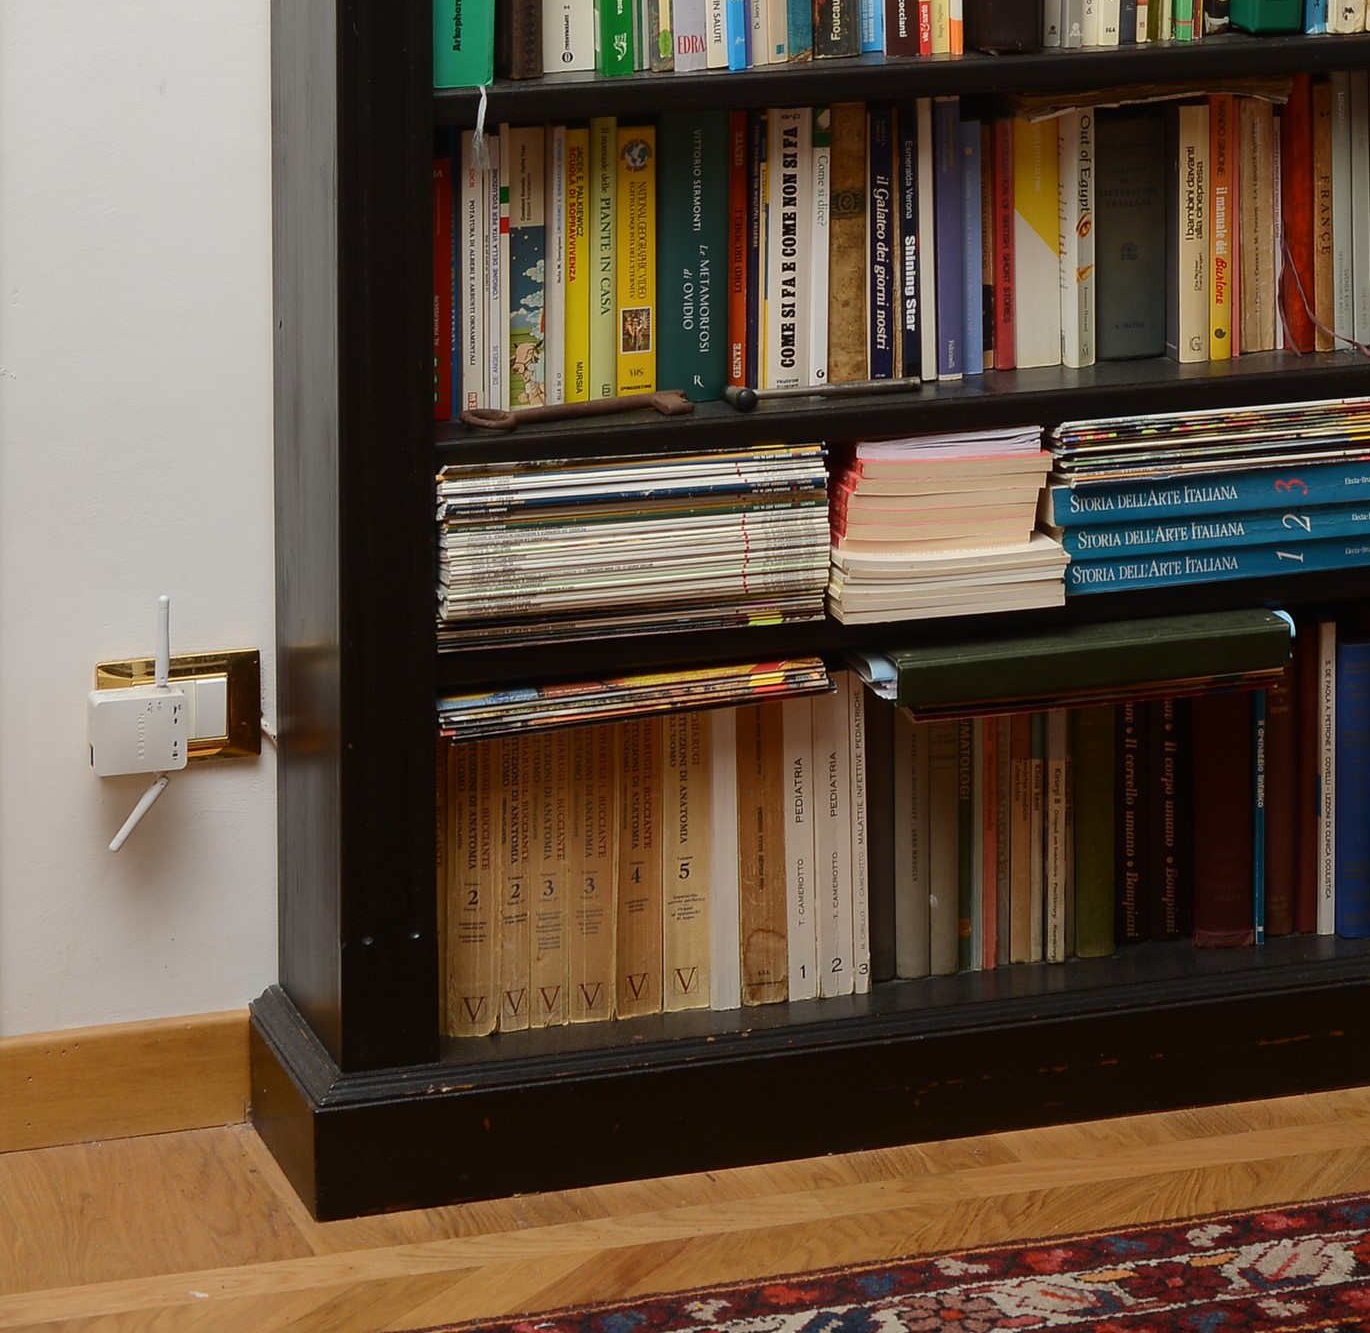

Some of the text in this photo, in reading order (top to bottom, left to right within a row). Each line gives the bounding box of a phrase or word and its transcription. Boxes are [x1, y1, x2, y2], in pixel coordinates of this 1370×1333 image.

[1077, 115, 1091, 213] Out of Egypt
[1320, 174, 1331, 257] FRANCE
[781, 126, 797, 368] COME SI FA E COME NON SI FA
[905, 236, 916, 332] Shining Star
[1069, 493, 1115, 513] STORIA
[1184, 485, 1238, 505] ITALIANA
[1275, 479, 1309, 495] 3
[1078, 529, 1123, 549] STORIA
[1191, 522, 1245, 540] ITALIANA
[1282, 514, 1312, 532] 2
[1276, 549, 1304, 562] 1
[1072, 564, 1116, 584] STORIA
[1185, 556, 1238, 576] ITALIANA
[795, 758, 803, 824] PEDIATRIA
[800, 965, 806, 979] 1
